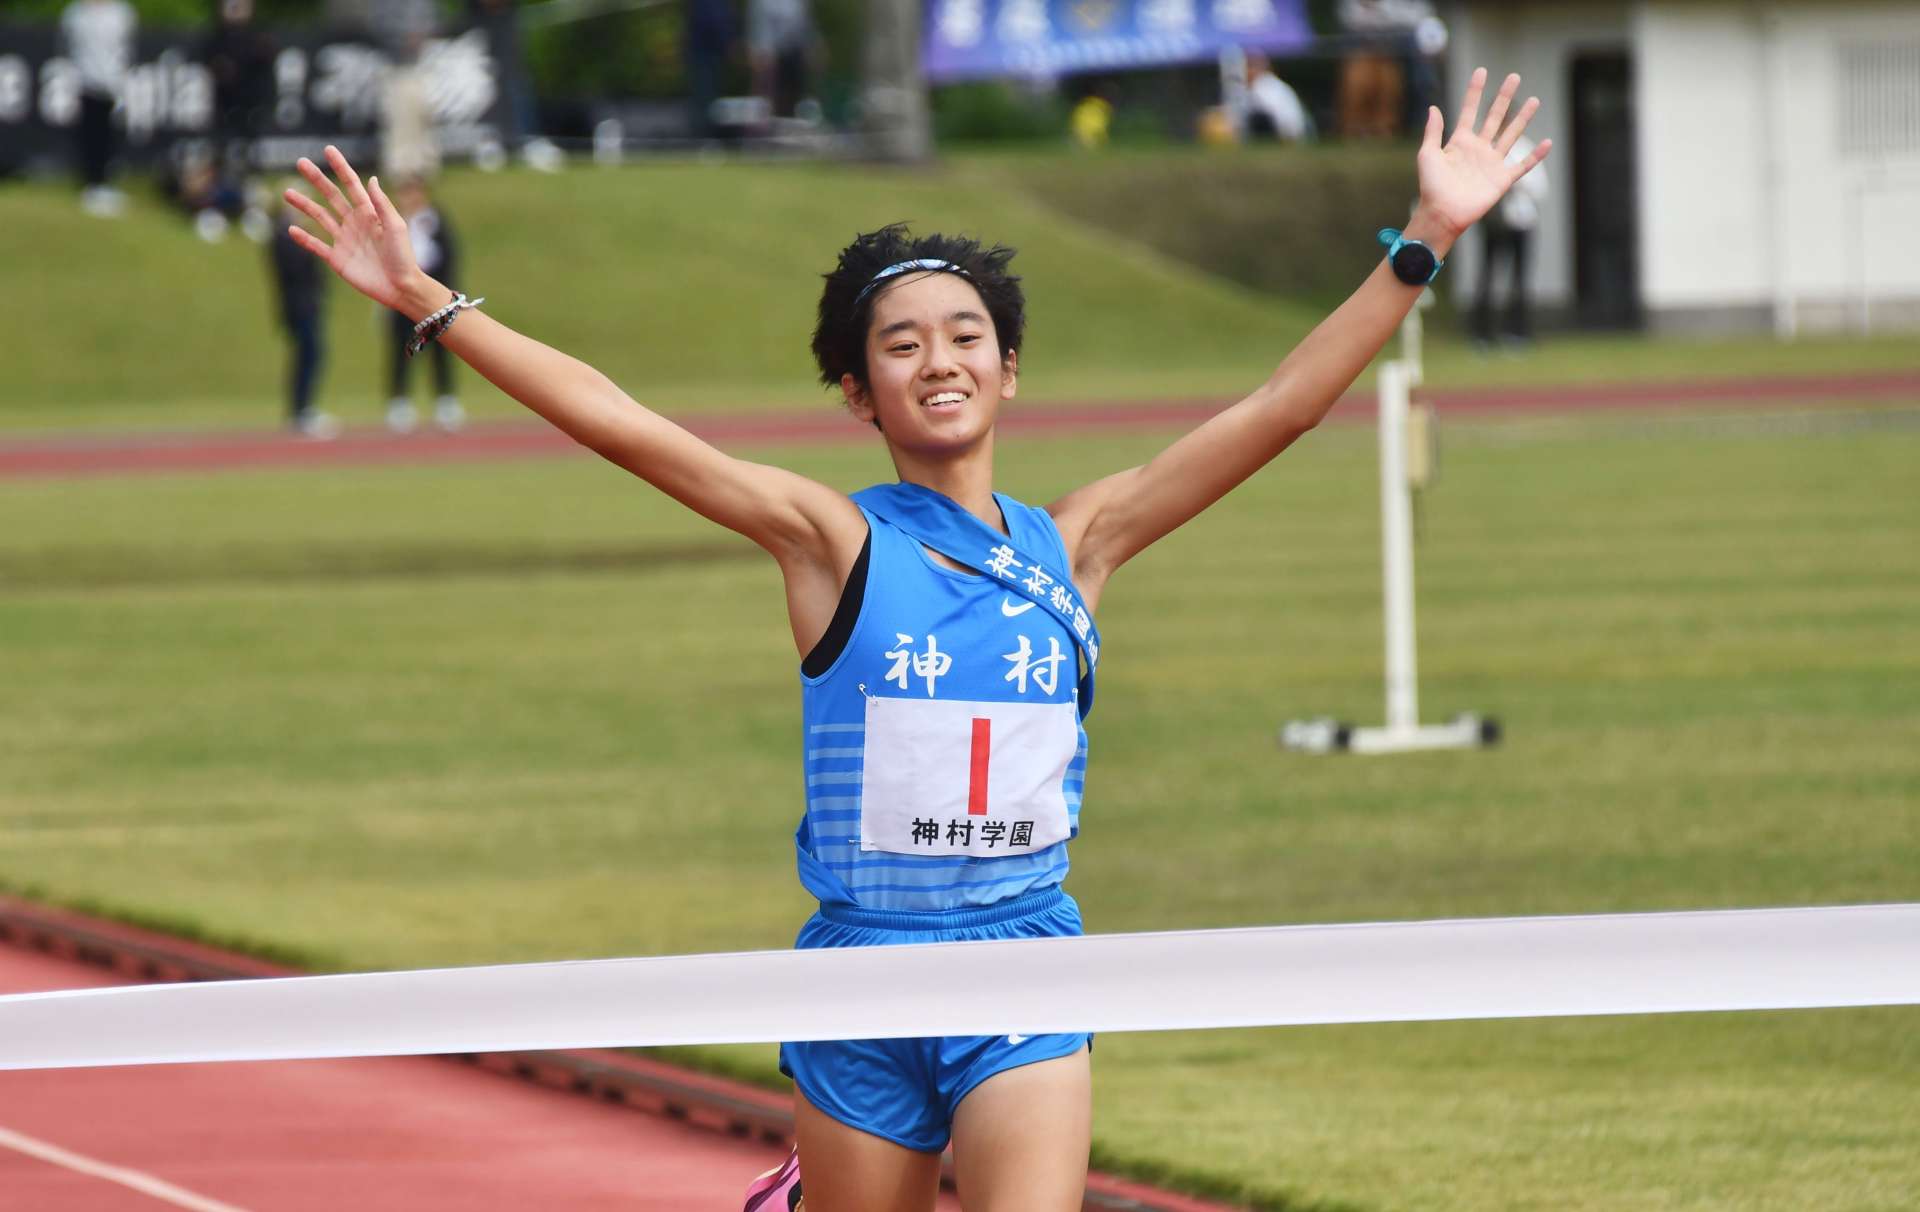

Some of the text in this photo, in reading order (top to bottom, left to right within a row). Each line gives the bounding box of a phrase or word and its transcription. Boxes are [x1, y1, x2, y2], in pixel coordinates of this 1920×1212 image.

[884, 633, 1067, 698] 神村
[968, 718, 991, 816] 1
[911, 817, 1034, 848] 神村学園
